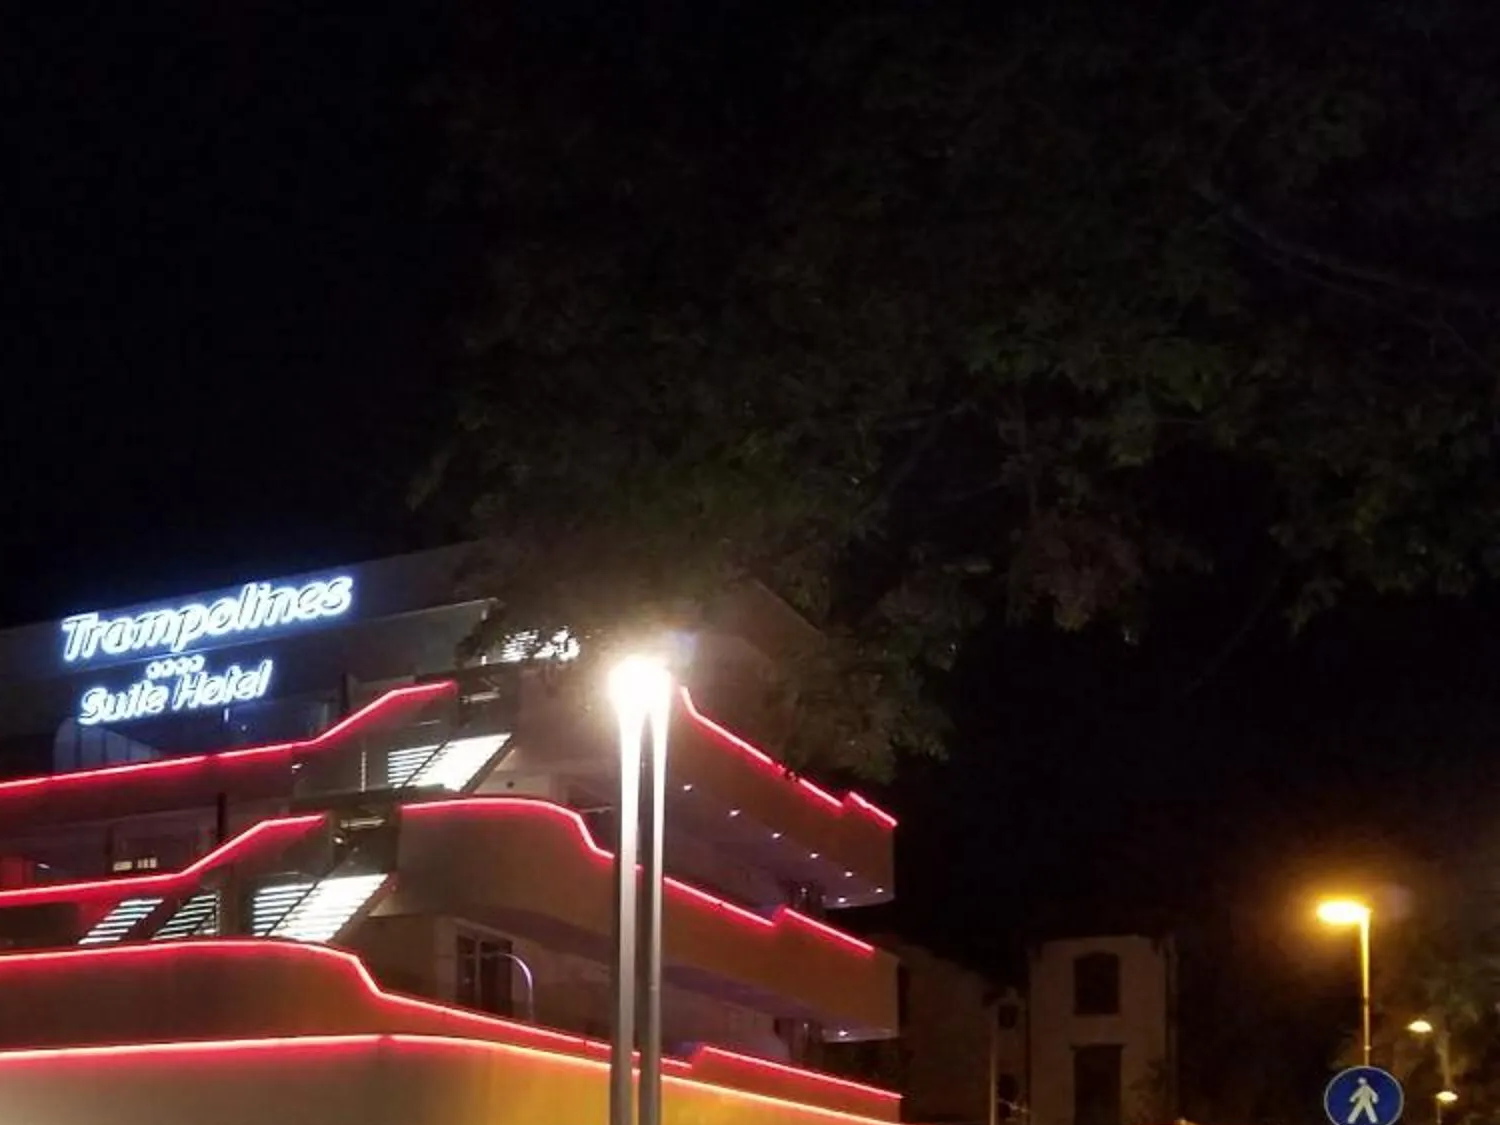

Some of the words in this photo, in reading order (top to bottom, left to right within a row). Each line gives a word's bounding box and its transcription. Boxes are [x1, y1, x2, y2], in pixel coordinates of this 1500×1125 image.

[62, 576, 353, 661] Trampolines
[79, 680, 167, 725] Suite
[174, 659, 274, 711] Hotel
